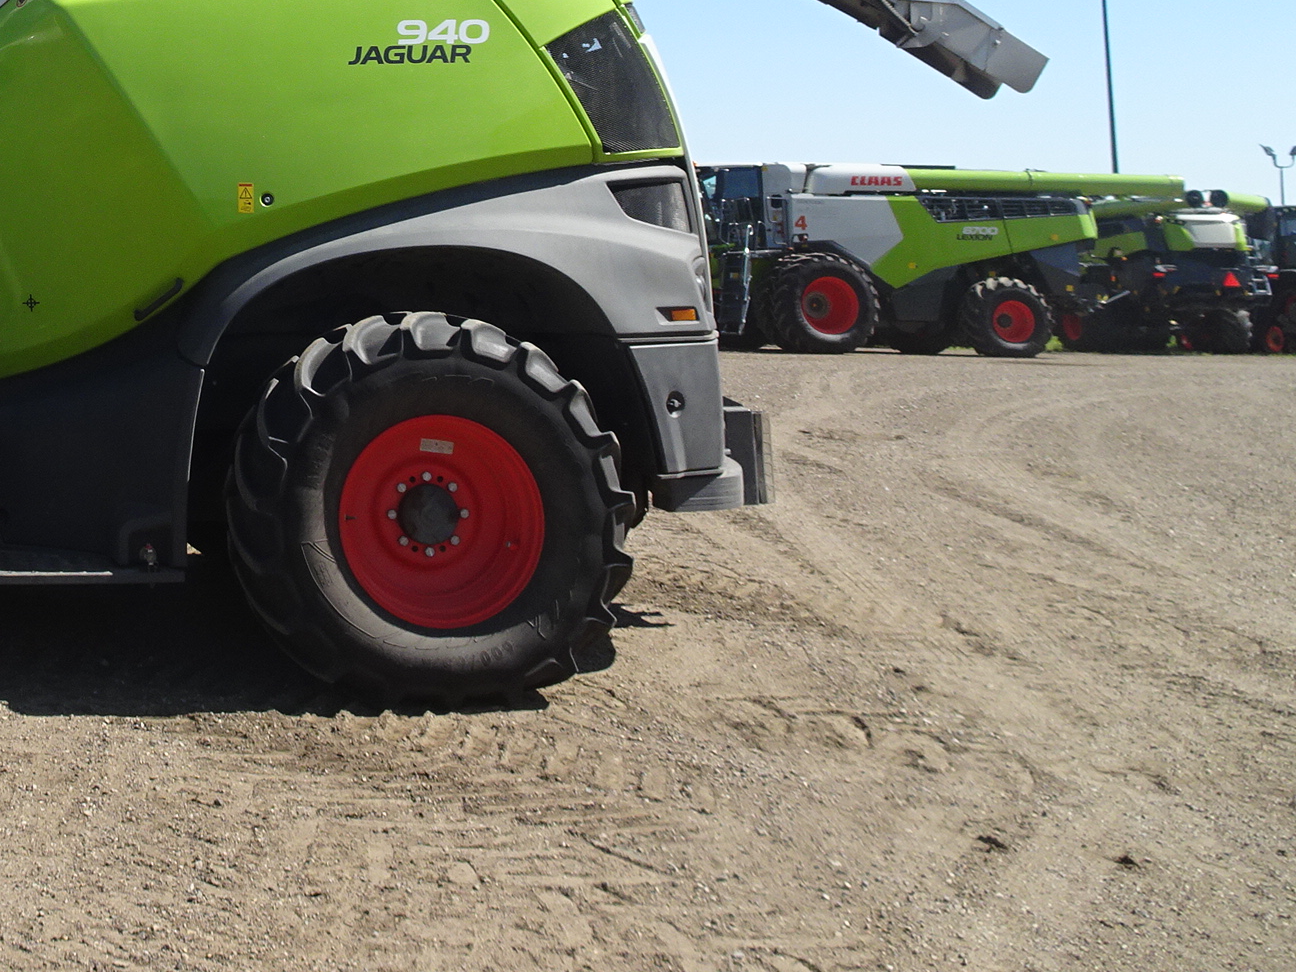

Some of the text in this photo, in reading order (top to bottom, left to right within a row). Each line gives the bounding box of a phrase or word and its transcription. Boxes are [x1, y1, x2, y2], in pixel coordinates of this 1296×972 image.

[397, 19, 490, 45] 940
[348, 44, 472, 65] JAGUAR
[850, 176, 903, 186] CLAAS
[794, 215, 808, 231] 4
